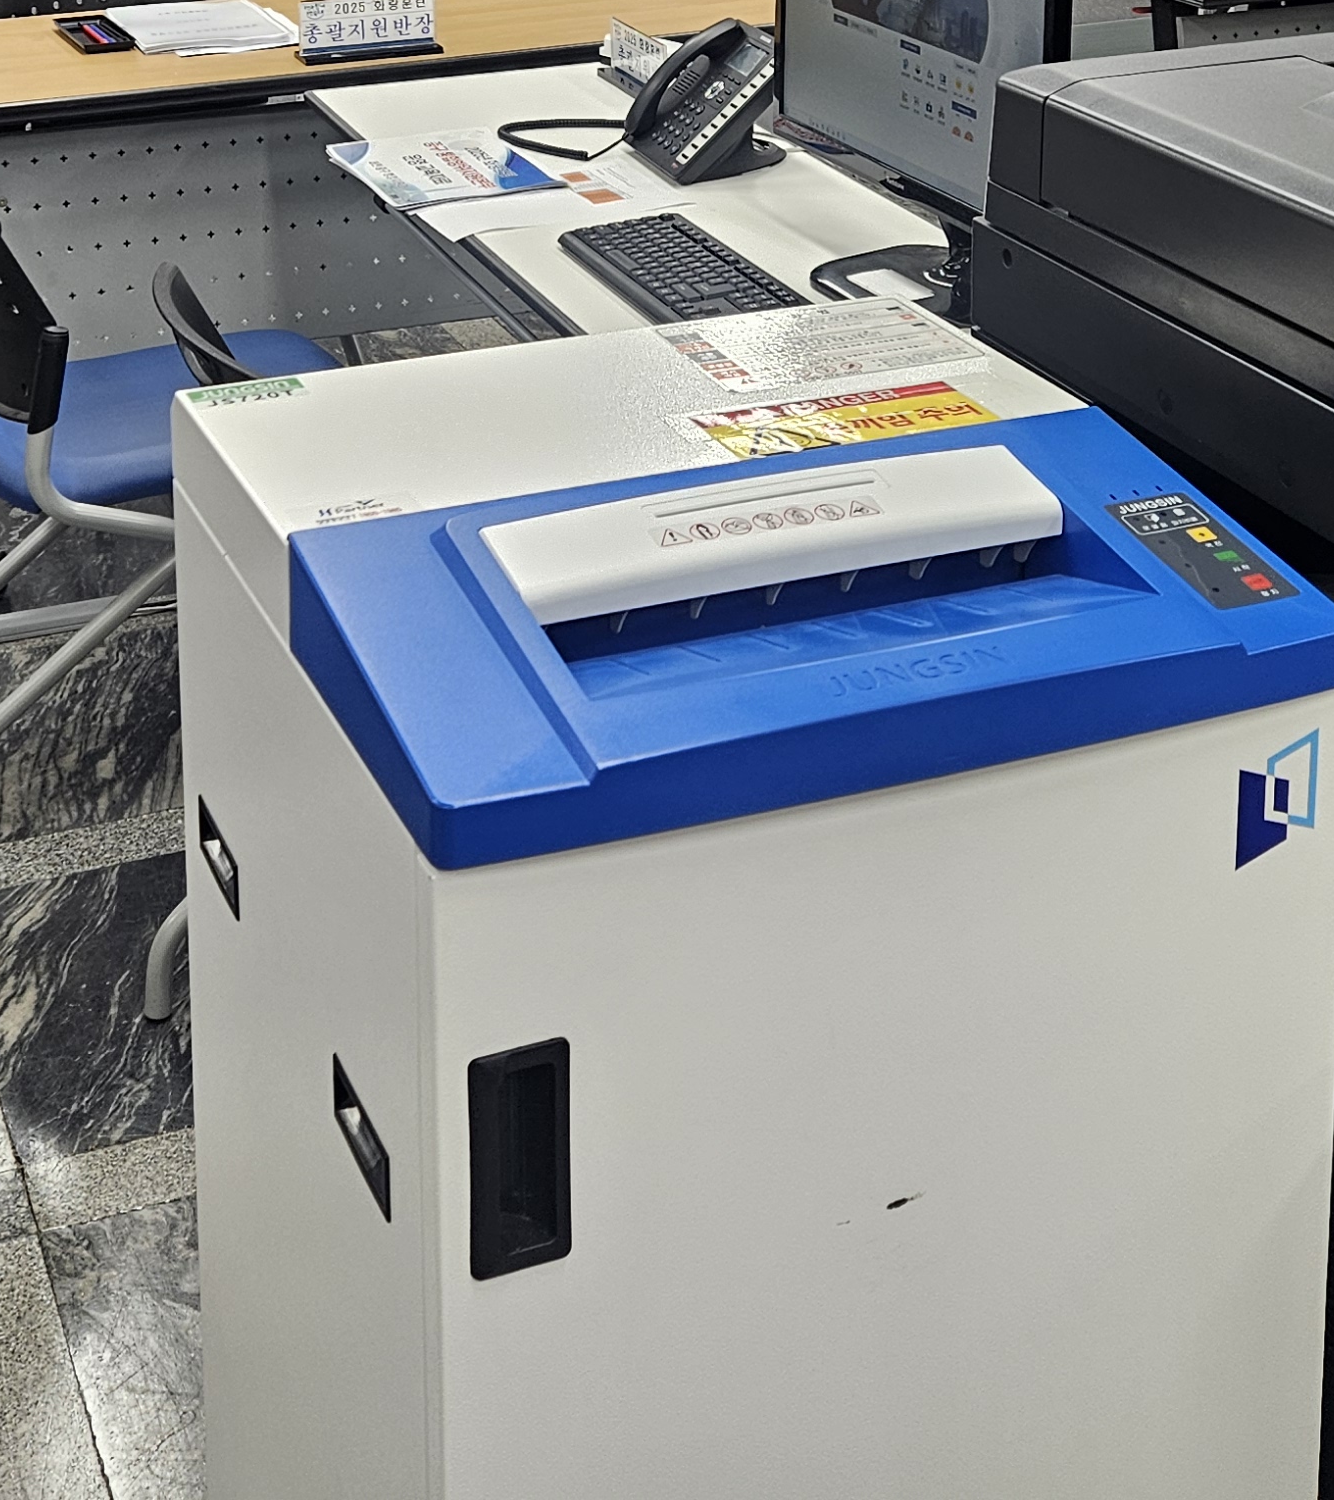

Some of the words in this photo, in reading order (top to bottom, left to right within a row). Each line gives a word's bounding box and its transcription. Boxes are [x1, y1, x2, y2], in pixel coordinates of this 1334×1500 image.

[334, 2, 366, 15] 2025
[303, 13, 434, 45] 총괄지원반장
[200, 380, 291, 399] JUNGSIN
[207, 390, 294, 407] JS720T
[918, 402, 983, 422] 주의
[1119, 495, 1184, 514] JUNGSIN
[830, 646, 1009, 697] JUNGSIN
